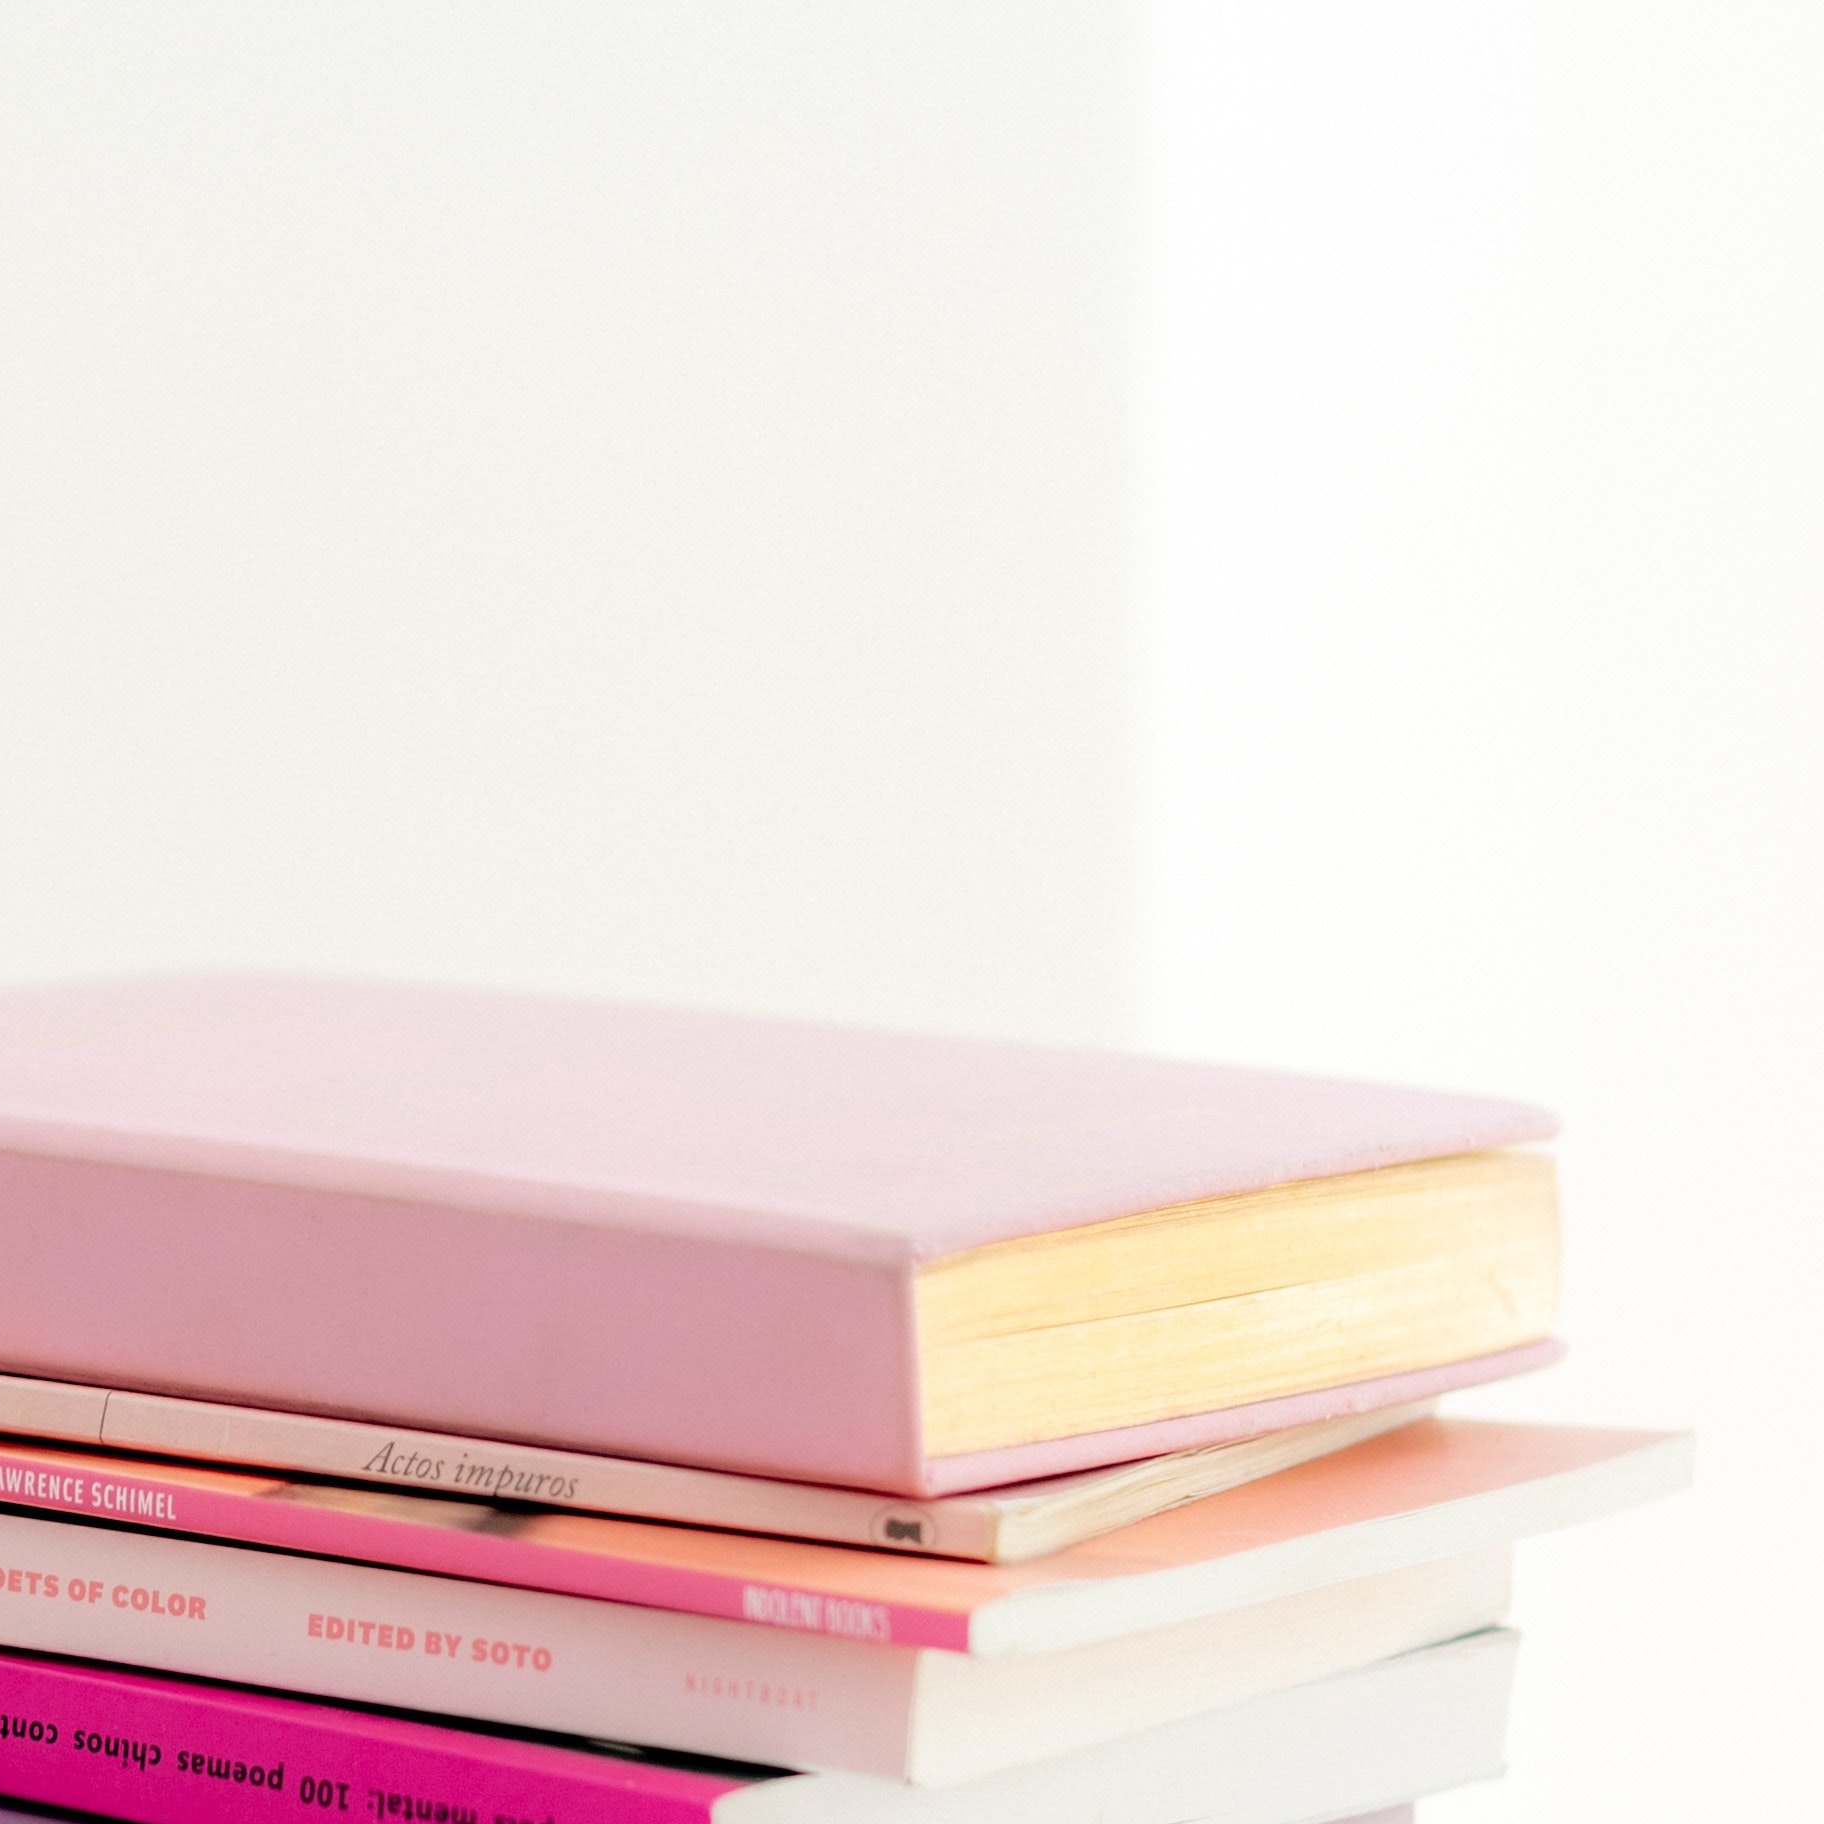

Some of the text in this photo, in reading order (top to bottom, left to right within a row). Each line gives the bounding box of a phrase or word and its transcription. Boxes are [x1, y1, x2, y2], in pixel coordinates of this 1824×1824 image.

[362, 1441, 579, 1498] Actos impuros
[91, 1480, 177, 1520] SCHIMEL
[68, 1578, 104, 1604] OF
[112, 1584, 208, 1620] COLOR
[307, 1612, 554, 1672] EDITED BY SOTO
[73, 1727, 163, 1772] chinos
[177, 1749, 285, 1792] poemas
[299, 1774, 350, 1811] 100
